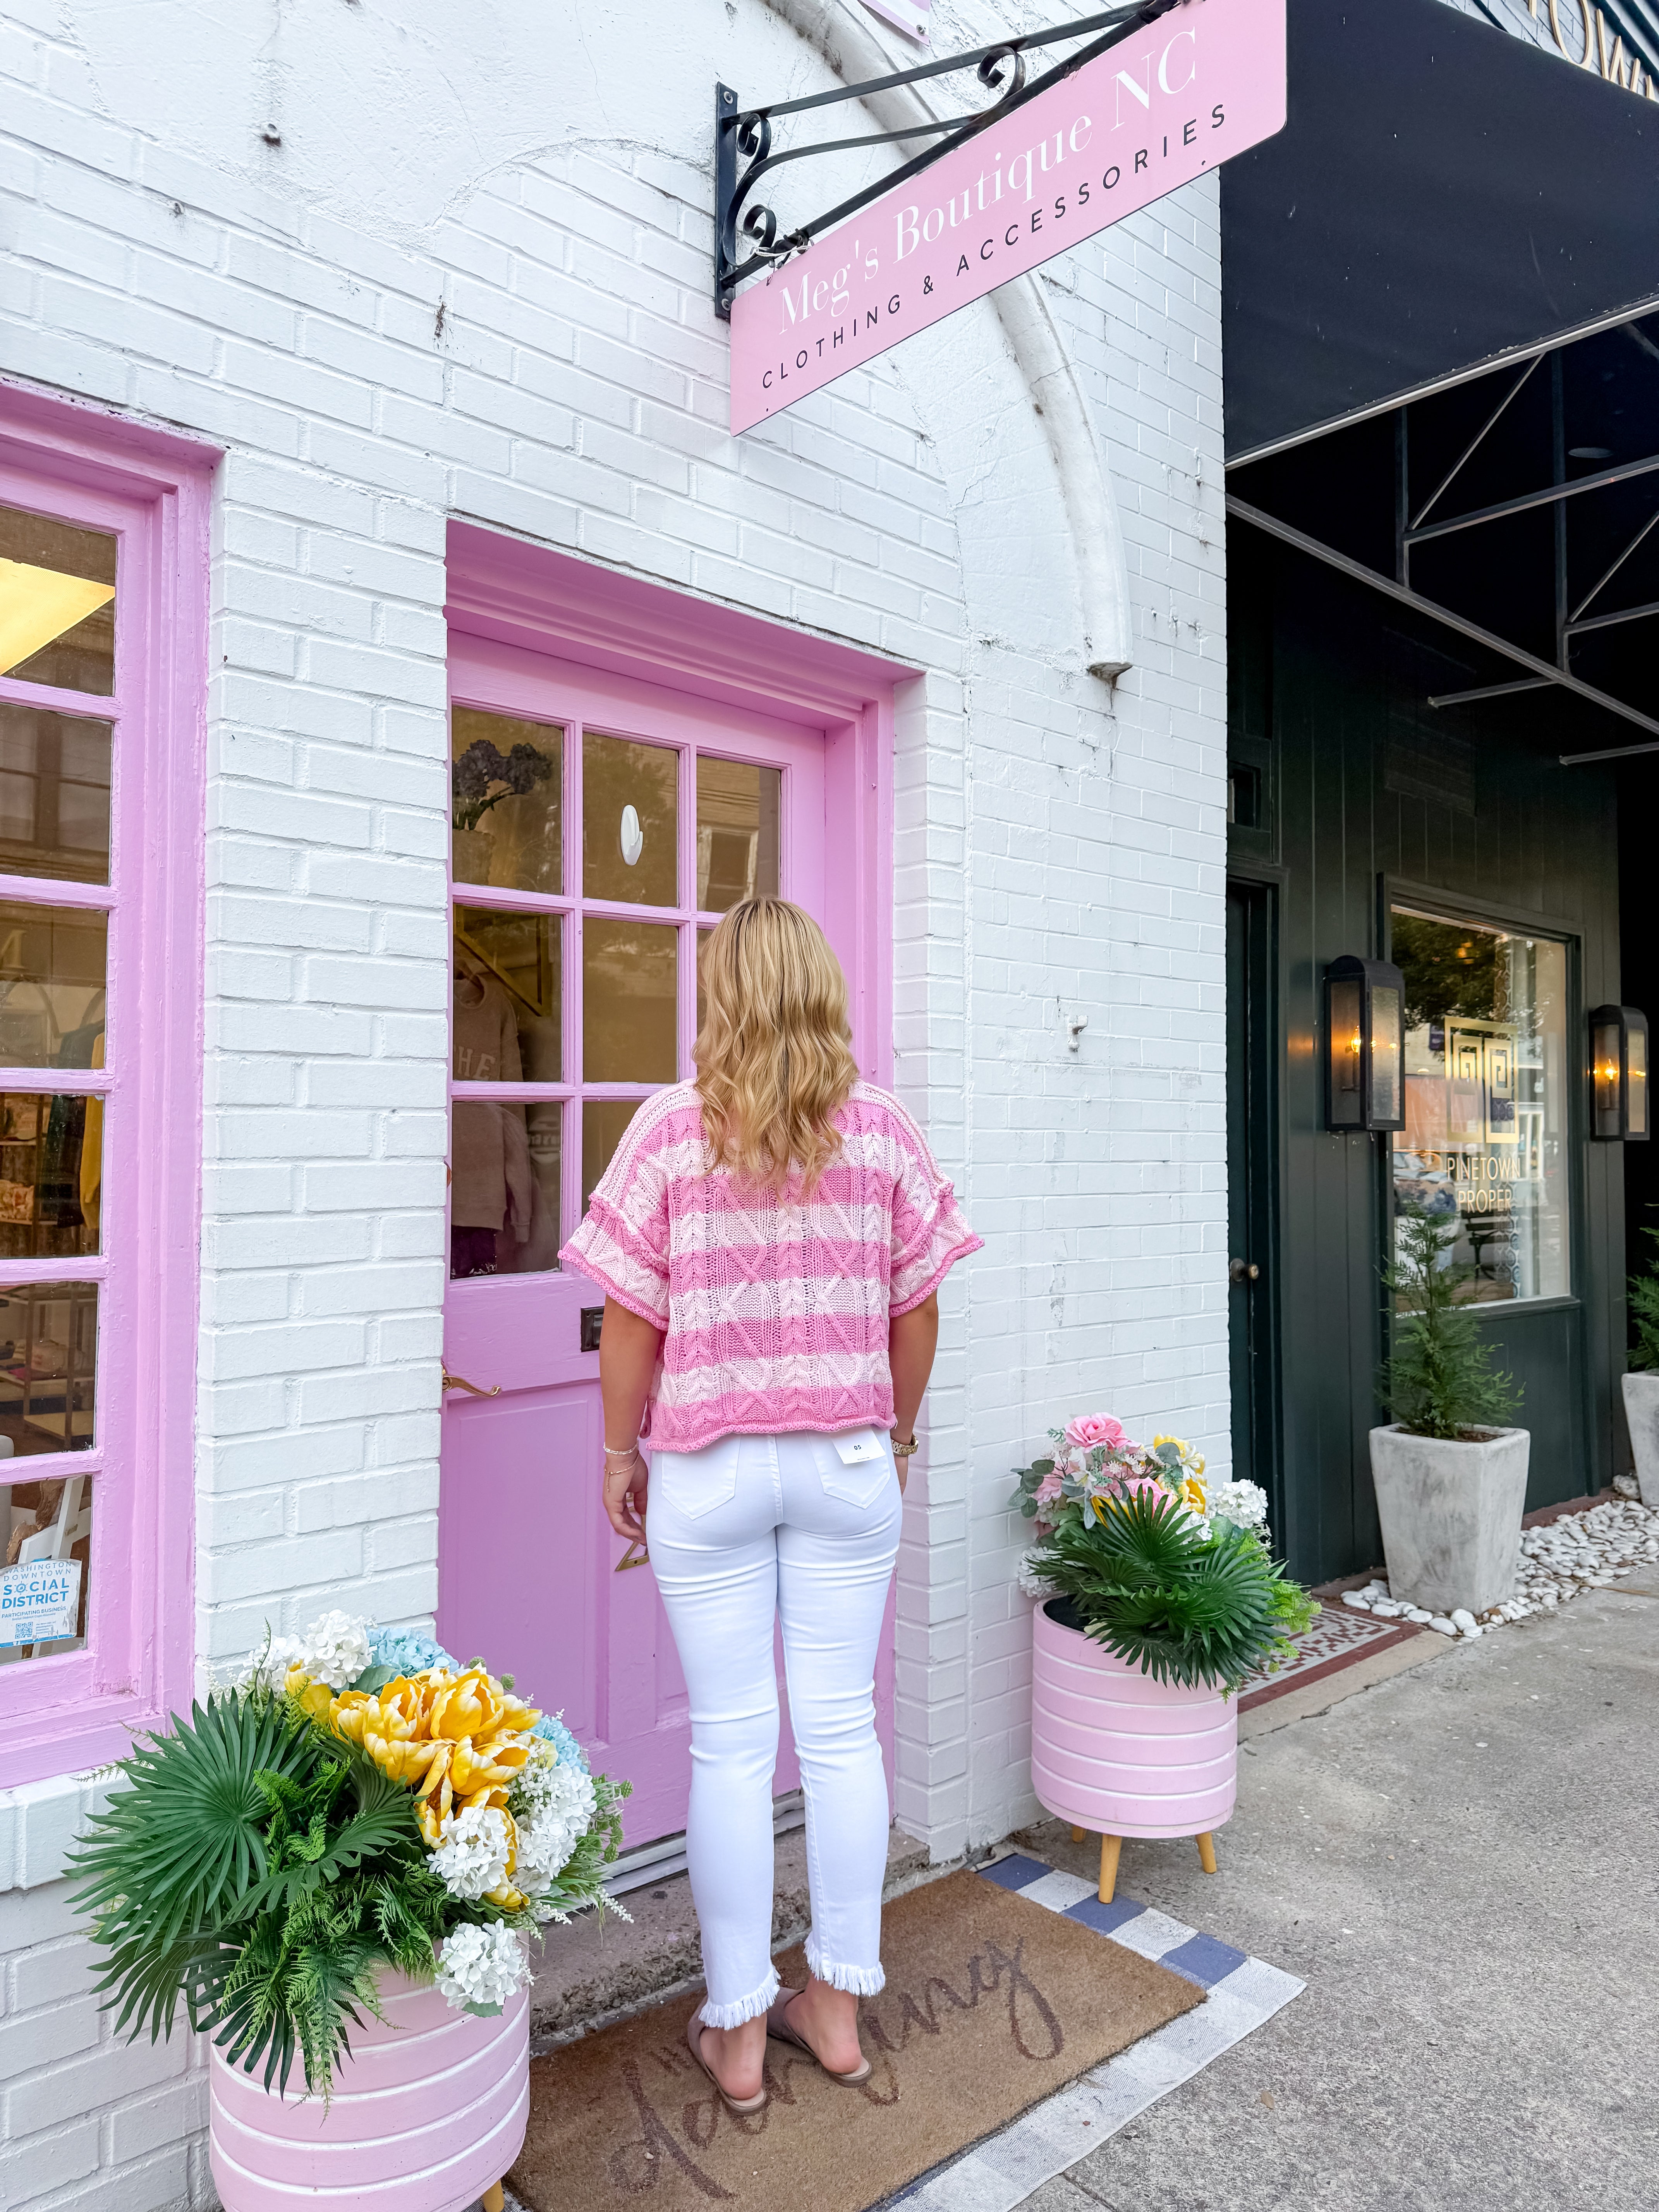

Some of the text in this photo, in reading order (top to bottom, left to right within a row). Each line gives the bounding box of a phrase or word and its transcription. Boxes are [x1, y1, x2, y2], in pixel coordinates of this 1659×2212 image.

[778, 27, 1197, 335] Meg's Boutique NC
[761, 103, 1228, 389] CLOTHING & ACCESSORIES
[1447, 1156, 1521, 1181] PINETOWN
[1458, 1189, 1512, 1213] PROPER
[4, 1569, 71, 1581] DOWNTOWN
[3, 1578, 69, 1595] SOCIAL
[2, 1591, 69, 1609] DISTRICT
[2, 1610, 40, 1618] PARTICIPATING
